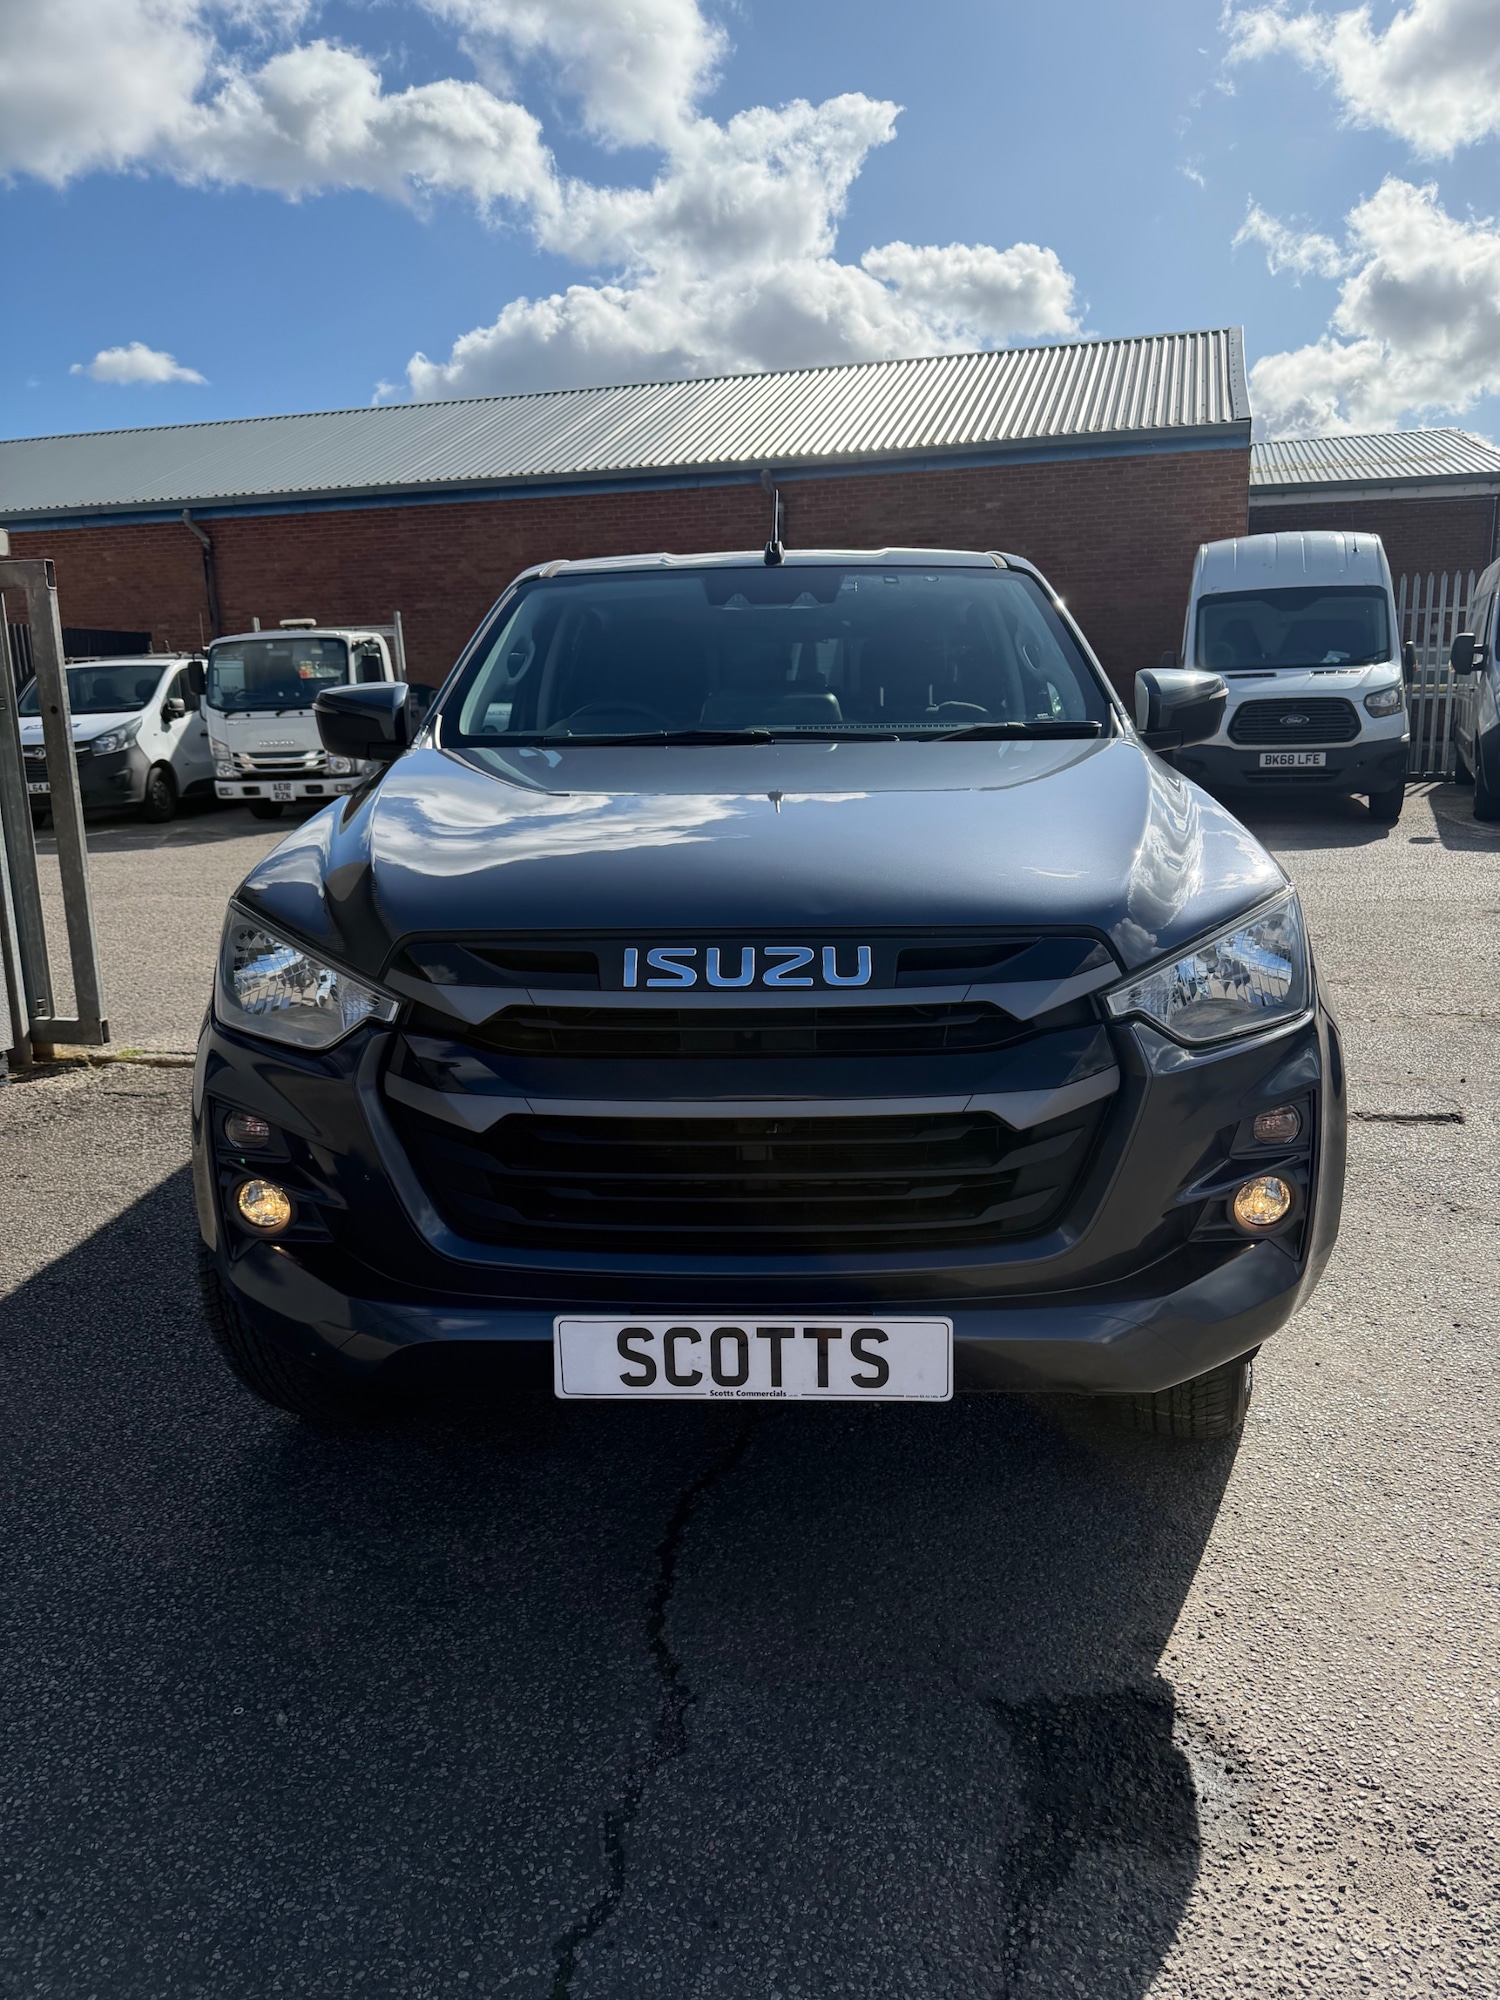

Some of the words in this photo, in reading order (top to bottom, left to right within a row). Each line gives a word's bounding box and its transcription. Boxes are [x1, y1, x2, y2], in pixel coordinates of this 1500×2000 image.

[1264, 754, 1295, 765] BK68
[1297, 754, 1321, 765] LFE
[28, 784, 43, 793] L64
[273, 782, 292, 791] AE18
[274, 792, 292, 800] RZN
[622, 945, 873, 989] ISUZU
[617, 1327, 890, 1388] SCOTTS
[709, 1389, 734, 1397] Scotts
[735, 1389, 787, 1397] Commercials
